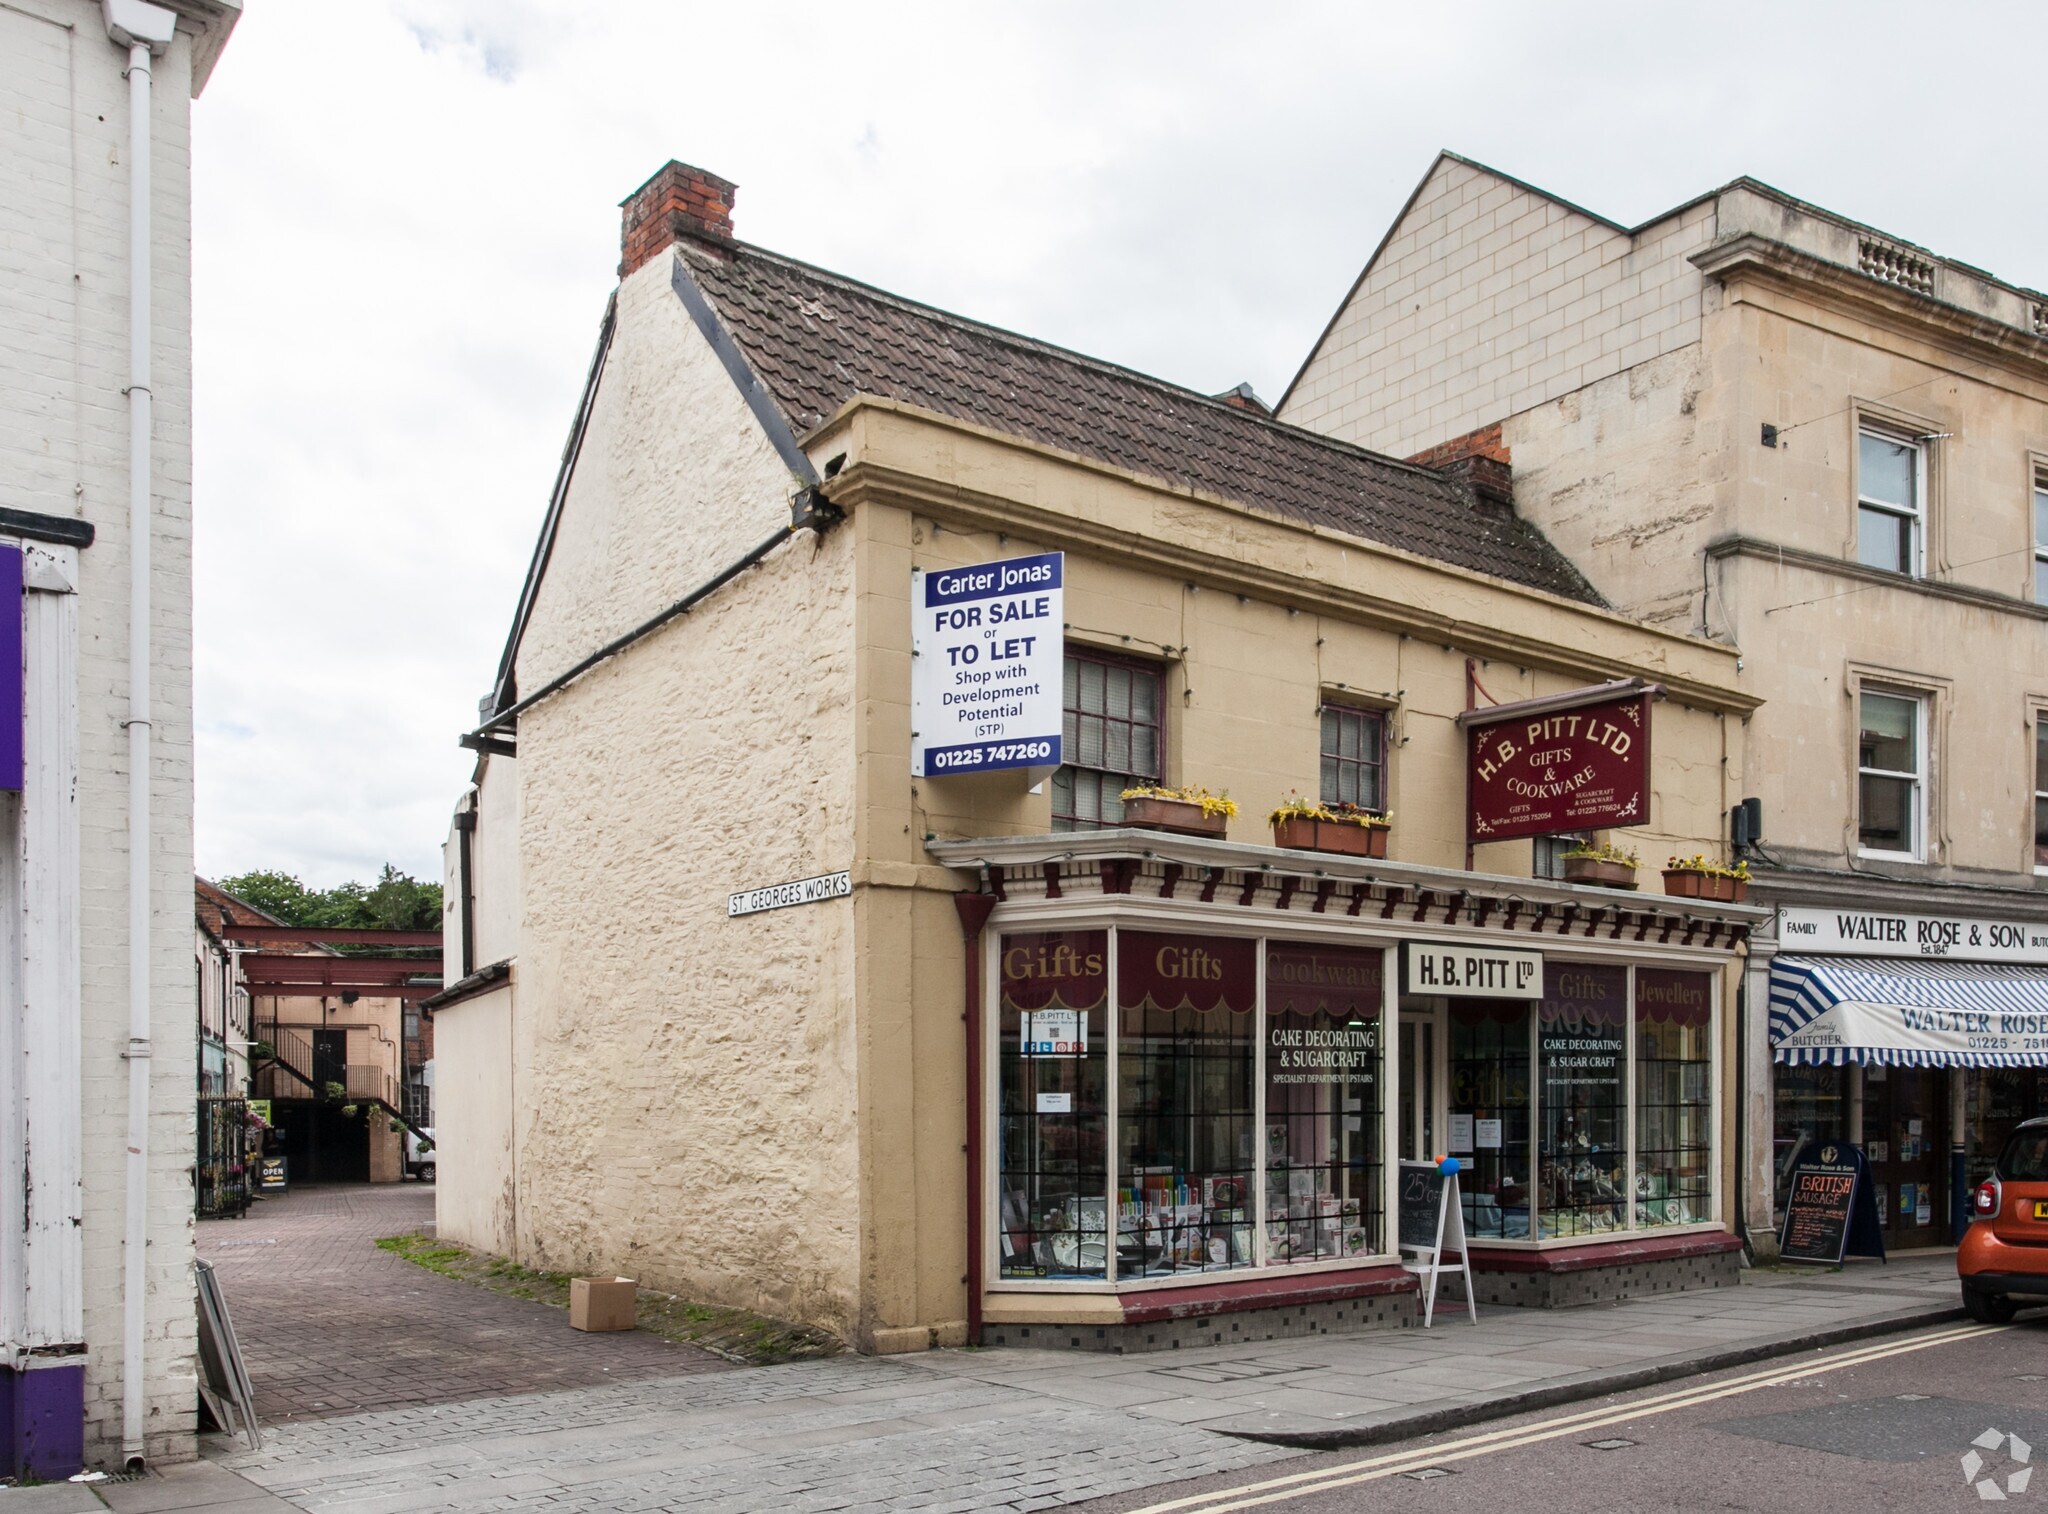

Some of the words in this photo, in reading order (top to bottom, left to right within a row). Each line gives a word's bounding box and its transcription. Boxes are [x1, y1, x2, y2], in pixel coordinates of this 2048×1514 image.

[937, 571, 995, 596] Carter
[998, 564, 1052, 591] Jonas
[935, 607, 982, 632] FOR
[989, 597, 1050, 624] SALE
[984, 629, 997, 639] or
[947, 645, 979, 666] TO
[990, 637, 1036, 661] LET
[955, 668, 991, 685] Shop
[995, 664, 1027, 680] with
[943, 683, 1040, 705] Development
[958, 703, 1023, 722] Potential
[974, 723, 1005, 738] (STP)
[1527, 716, 1581, 745] PITT
[1586, 719, 1631, 763] LTD.
[935, 749, 983, 767] 01225
[987, 742, 1050, 762] 747260
[1529, 748, 1572, 767] GIFTS
[1507, 765, 1596, 799] COOKWARE
[1543, 767, 1557, 782] &
[1575, 788, 1615, 798] SUGARCRAFT
[1580, 796, 1613, 805] COOKWARE
[1509, 804, 1531, 813] GIFTS
[1512, 814, 1530, 823] 01225
[1531, 812, 1552, 821] 752054
[1577, 806, 1597, 815] 01225
[732, 895, 747, 913] ST.
[751, 884, 801, 909] GEORGES
[805, 875, 847, 899] WORKS
[1787, 921, 1817, 935] FAMILY
[1837, 915, 1907, 943] WALTER
[1917, 920, 1961, 945] ROSE
[1968, 925, 1982, 947] &
[1989, 925, 2025, 949] SON
[1004, 945, 1103, 980] Gifts
[1155, 946, 1223, 980] Gifts
[1266, 952, 1381, 986] Cookware
[1465, 957, 1509, 989] PITT
[1559, 973, 1607, 1000] Gifts
[1637, 979, 1704, 1010] Jewellery
[1807, 1021, 1837, 1034] Family
[1900, 1008, 1991, 1033] WALTER
[2001, 1014, 2048, 1034] ROSE
[1272, 1029, 1302, 1046] CAKE
[1305, 1030, 1375, 1047] DECORATING
[1543, 1039, 1567, 1050] CAKE
[1568, 1040, 1622, 1050] DECORATING
[1792, 1034, 1843, 1046] BUTCHER
[1968, 1037, 2008, 1049] 01225
[1280, 1050, 1290, 1067] &
[1293, 1051, 1367, 1067] SUGARCRAFT
[1550, 1056, 1557, 1067] &
[1559, 1056, 1588, 1067] SUGAR
[1589, 1057, 1616, 1067] CRAFT
[1273, 1074, 1306, 1083] SPECIALIST
[1307, 1074, 1345, 1083] DEPARTMENT
[1346, 1074, 1373, 1083] UPSTAIRS
[262, 1167, 284, 1176] OPEN
[1801, 1176, 1853, 1194] BRITISH
[1794, 1192, 1841, 1205] SAUSAGE
